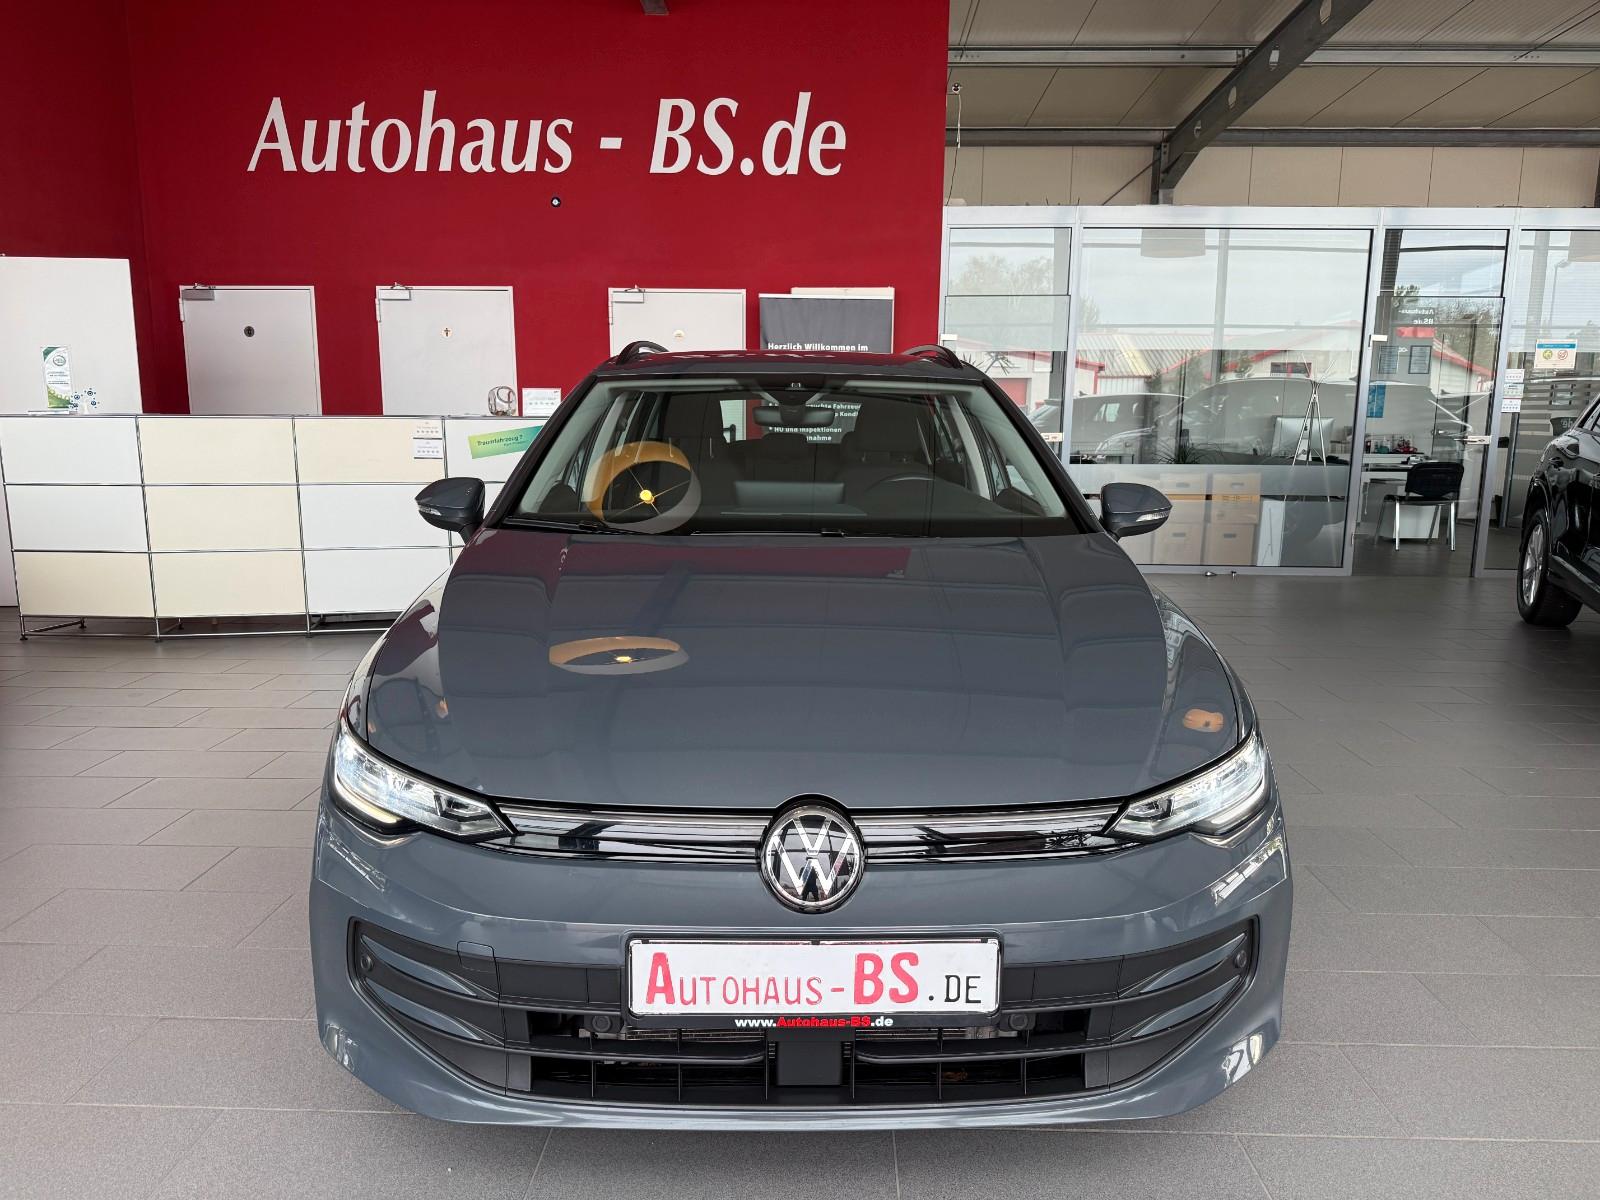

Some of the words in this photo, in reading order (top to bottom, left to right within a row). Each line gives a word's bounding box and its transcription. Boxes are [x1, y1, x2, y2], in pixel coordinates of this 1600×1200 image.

[247, 89, 573, 174] Autohaus
[649, 91, 847, 176] BS.de
[767, 342, 803, 350] Herzlich
[804, 343, 856, 351] Willkommen
[857, 343, 869, 351] im
[735, 1016, 893, 1028] www.Autohaus-BS.de
